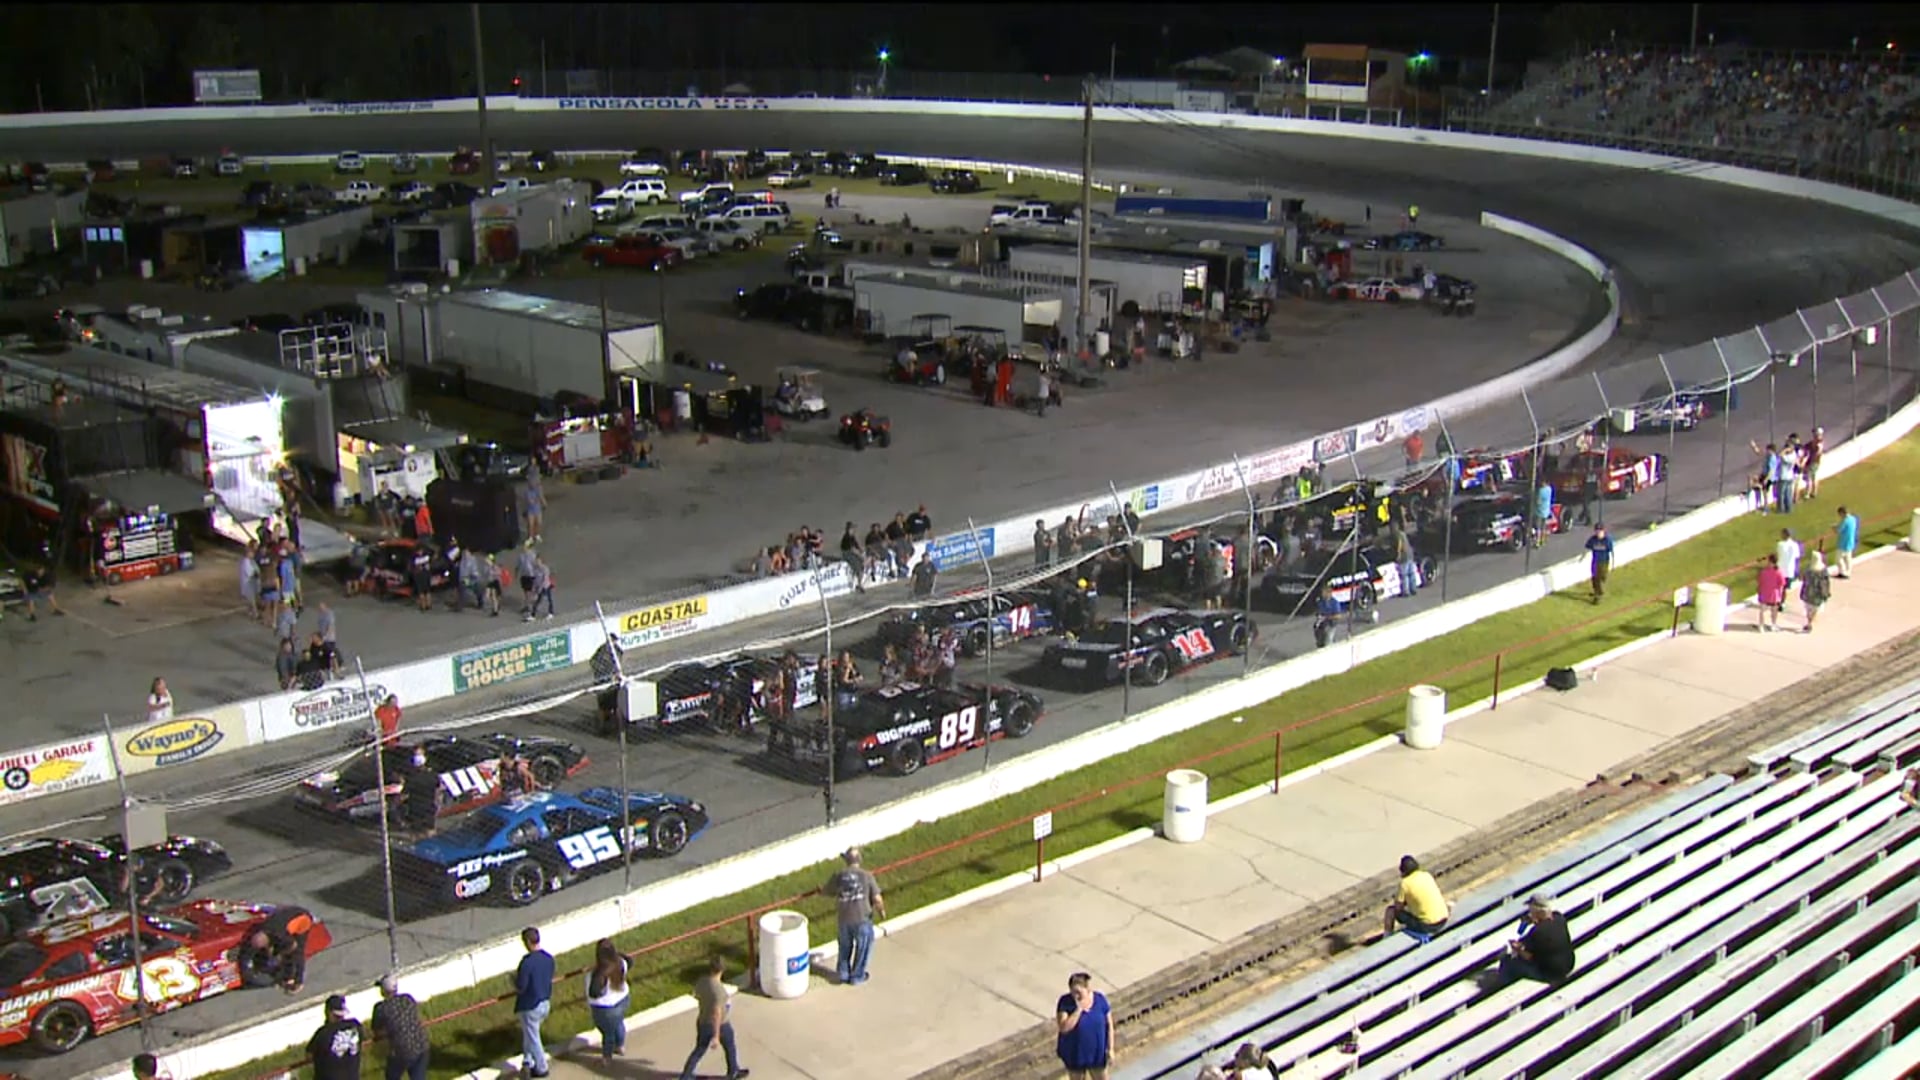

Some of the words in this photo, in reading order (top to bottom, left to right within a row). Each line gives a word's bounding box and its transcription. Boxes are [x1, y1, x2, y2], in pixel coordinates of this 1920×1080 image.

[559, 98, 702, 109] PENSACOLA
[779, 578, 808, 607] GULF
[627, 599, 703, 630] COASTAL
[1009, 604, 1031, 633] 14
[461, 642, 532, 677] CATFISH
[1171, 628, 1214, 661] 14
[467, 660, 526, 690] HOUSE
[136, 721, 209, 751] Wayne's
[940, 706, 977, 749] 89
[43, 741, 94, 762] GARAGE
[556, 825, 622, 869] 95
